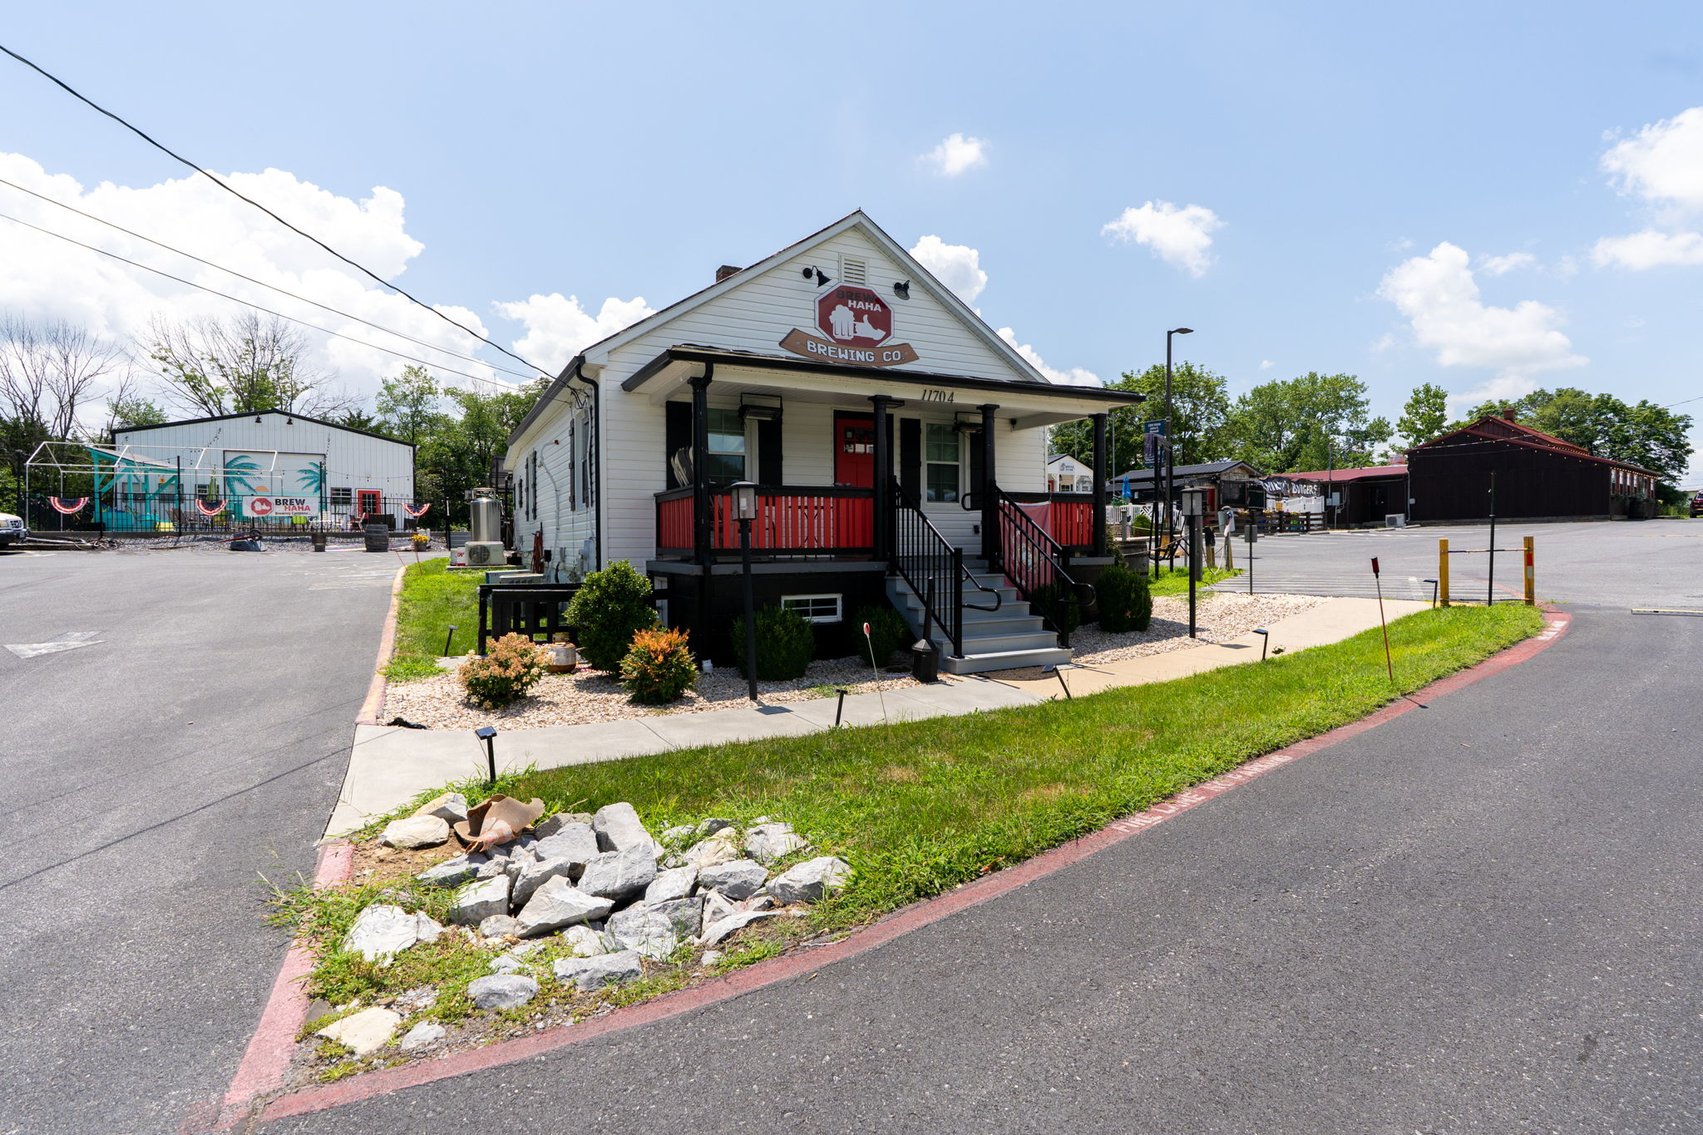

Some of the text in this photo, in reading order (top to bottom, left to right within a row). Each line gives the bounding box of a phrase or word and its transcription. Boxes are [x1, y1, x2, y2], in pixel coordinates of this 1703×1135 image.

[847, 300, 882, 312] HAHA
[807, 340, 875, 361] BREWING
[921, 389, 954, 403] 11704
